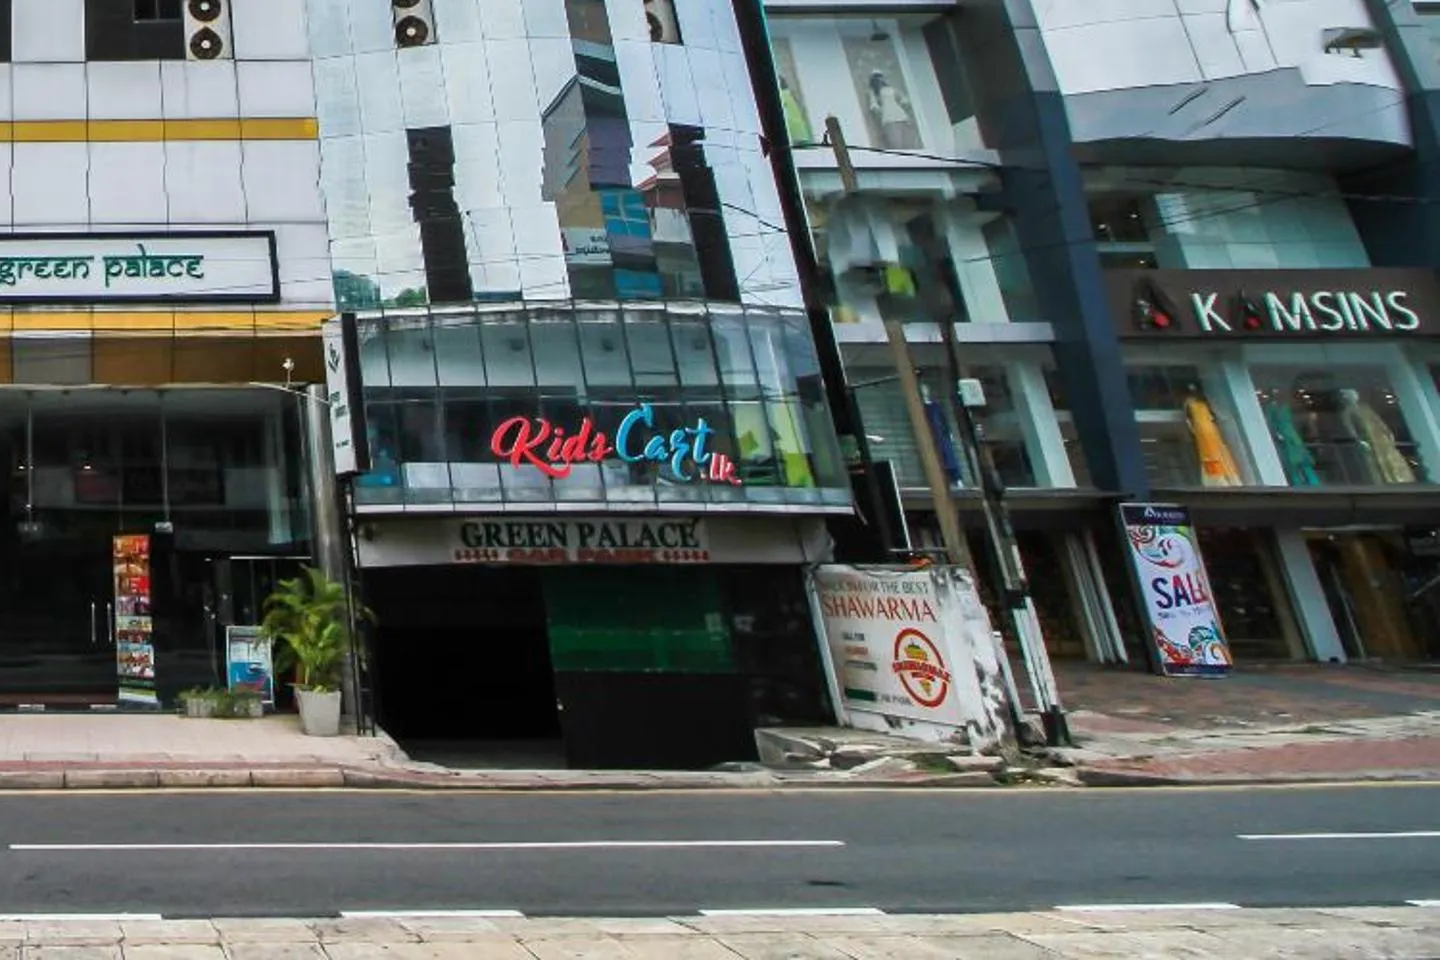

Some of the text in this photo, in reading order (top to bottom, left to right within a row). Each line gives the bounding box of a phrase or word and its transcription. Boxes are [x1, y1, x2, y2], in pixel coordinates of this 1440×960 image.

[102, 243, 204, 287] palace
[461, 521, 699, 548] GREEN PALACE
[902, 581, 929, 595] BEST
[823, 595, 938, 622] SHAWARMA
